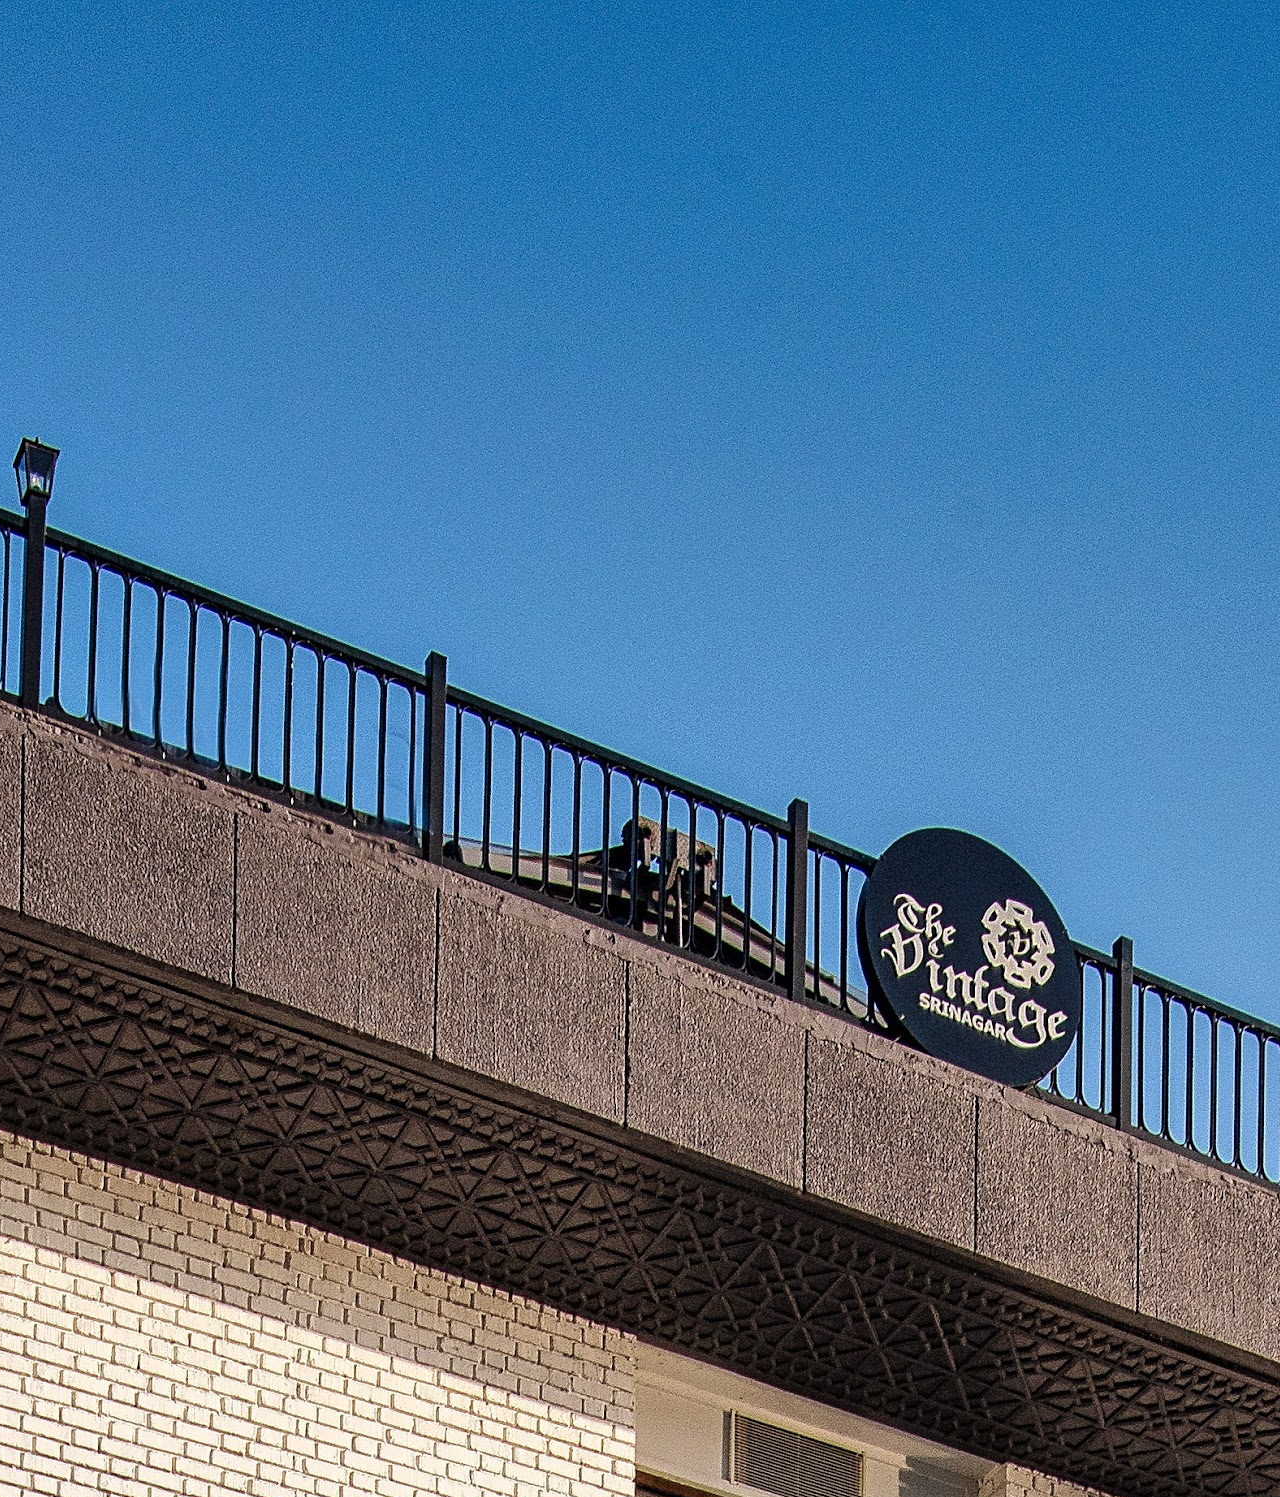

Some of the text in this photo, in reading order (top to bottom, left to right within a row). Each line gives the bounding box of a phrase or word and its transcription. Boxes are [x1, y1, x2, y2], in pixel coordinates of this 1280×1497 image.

[893, 893, 956, 957] The
[879, 922, 1068, 1048] Vintage
[919, 992, 1007, 1042] SRINAGAR
